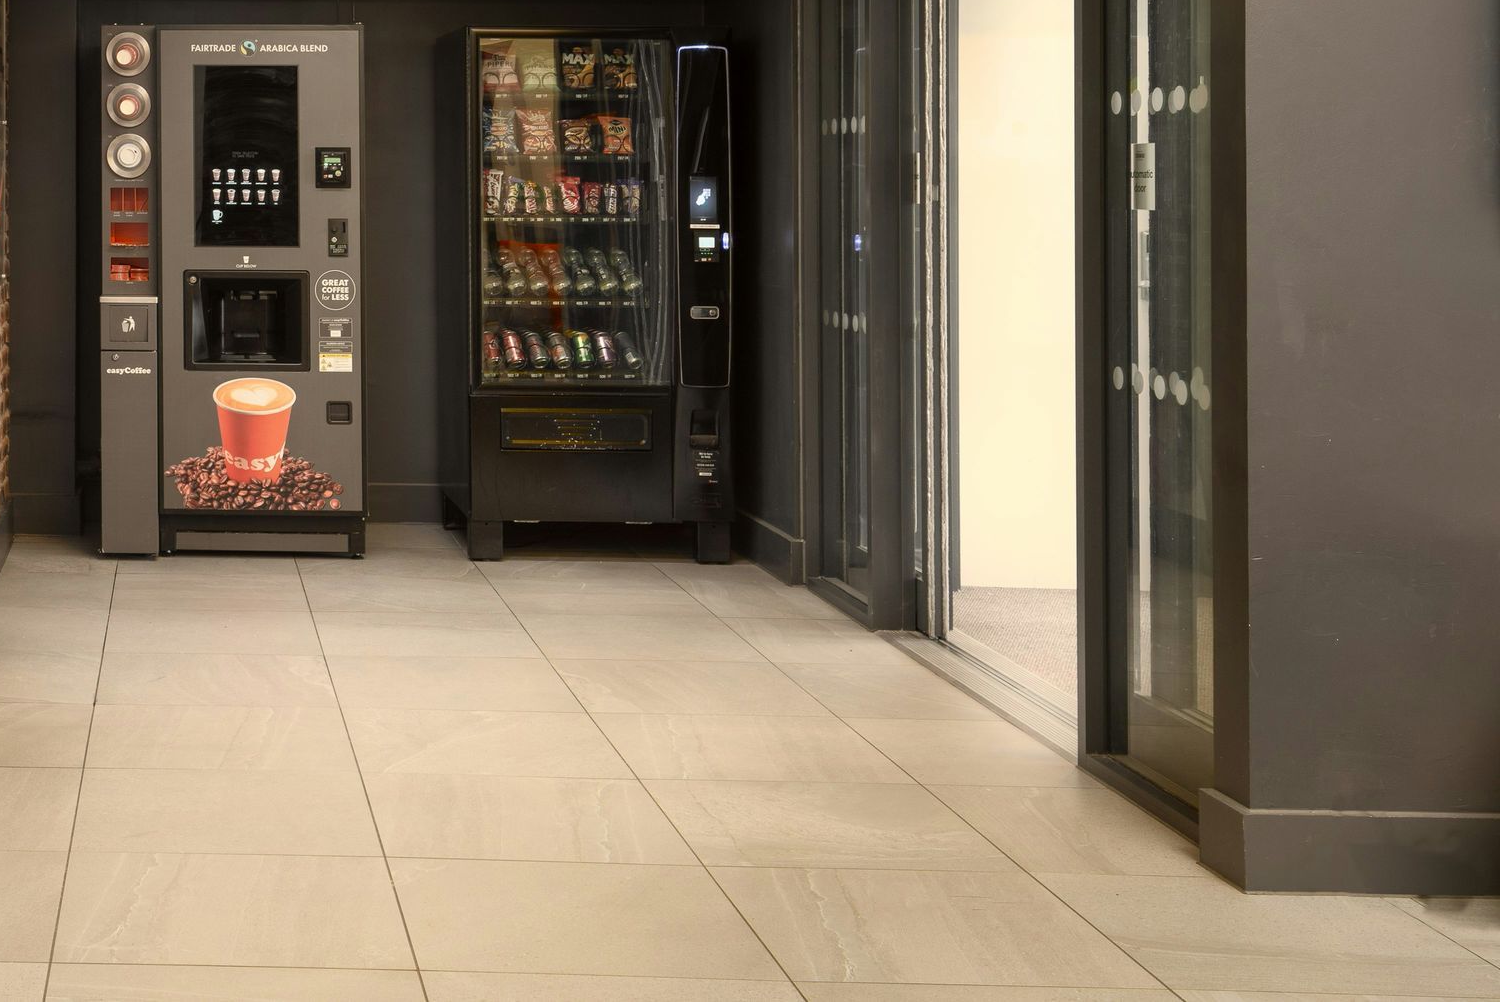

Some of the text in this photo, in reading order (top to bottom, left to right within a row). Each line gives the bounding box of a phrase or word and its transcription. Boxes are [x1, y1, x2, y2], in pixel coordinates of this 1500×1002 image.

[190, 44, 329, 53] FAIRTRADE ARABICA BLEND
[562, 52, 595, 65] MAX
[321, 286, 349, 294] COFFEE
[106, 367, 151, 375] easyCoffee
[225, 440, 286, 473] easy
